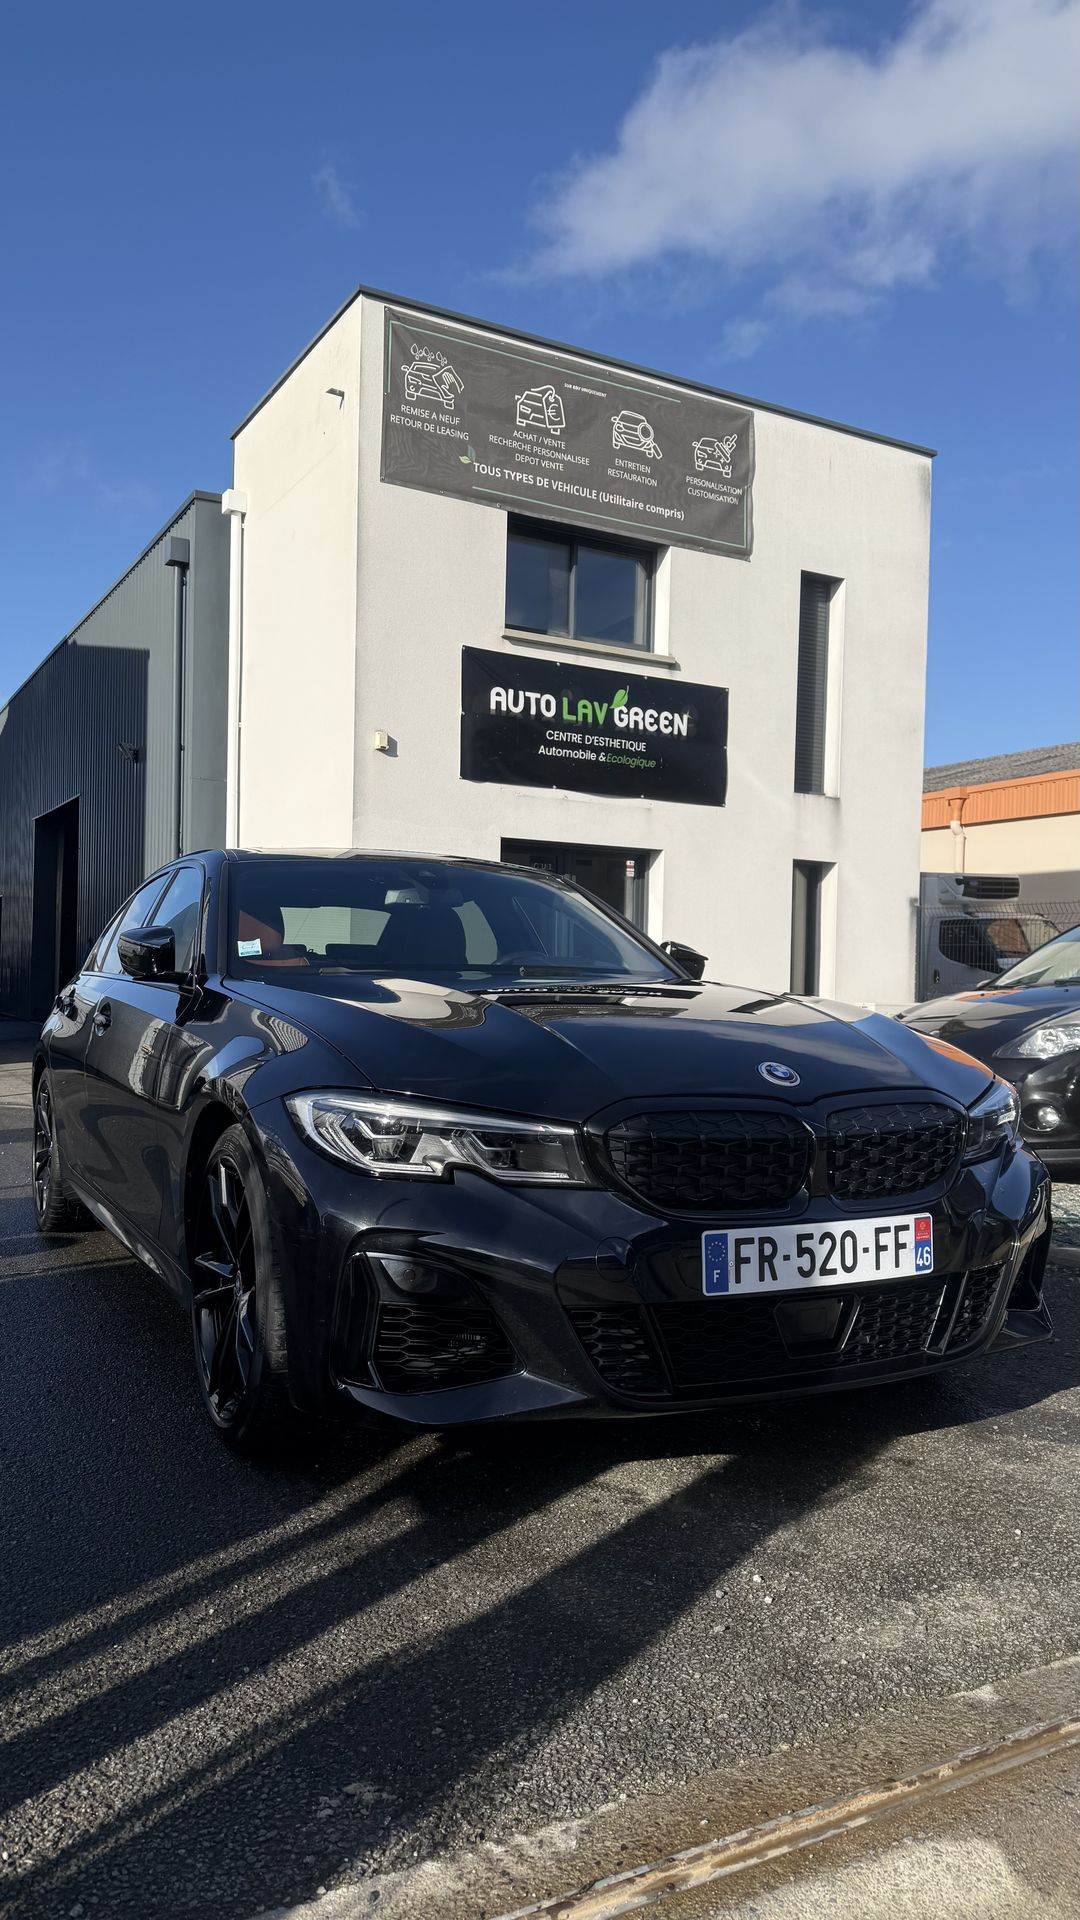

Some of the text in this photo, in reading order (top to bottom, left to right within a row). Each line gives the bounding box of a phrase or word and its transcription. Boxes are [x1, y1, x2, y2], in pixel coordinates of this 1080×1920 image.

[401, 404, 460, 426] REMISE A NEUF
[390, 414, 469, 441] RETOUR DE LEASING
[488, 434, 590, 466] RECHERCHE PERSONNALISEE
[513, 430, 537, 442] ACHAT
[543, 437, 566, 450] VENTE
[515, 453, 564, 471] DEPOT VENTE
[615, 458, 651, 474] ENTRETIEN
[607, 468, 658, 487] RESTAURATION
[685, 475, 743, 496] PERSONALISATION
[473, 462, 685, 521] TOUS TYPES DE VEHICULE (Utilitaire compris)
[687, 486, 739, 505] CUSTOMISATION
[489, 686, 689, 736] AUTO LAV GREEN
[545, 730, 647, 752] CENTRE D'ESTHETIQUE
[538, 745, 597, 761] Automobile
[606, 753, 656, 769] Ecologique
[734, 1223, 910, 1284] FR-520-FF
[916, 1246, 931, 1267] 46
[712, 1269, 721, 1283] F
